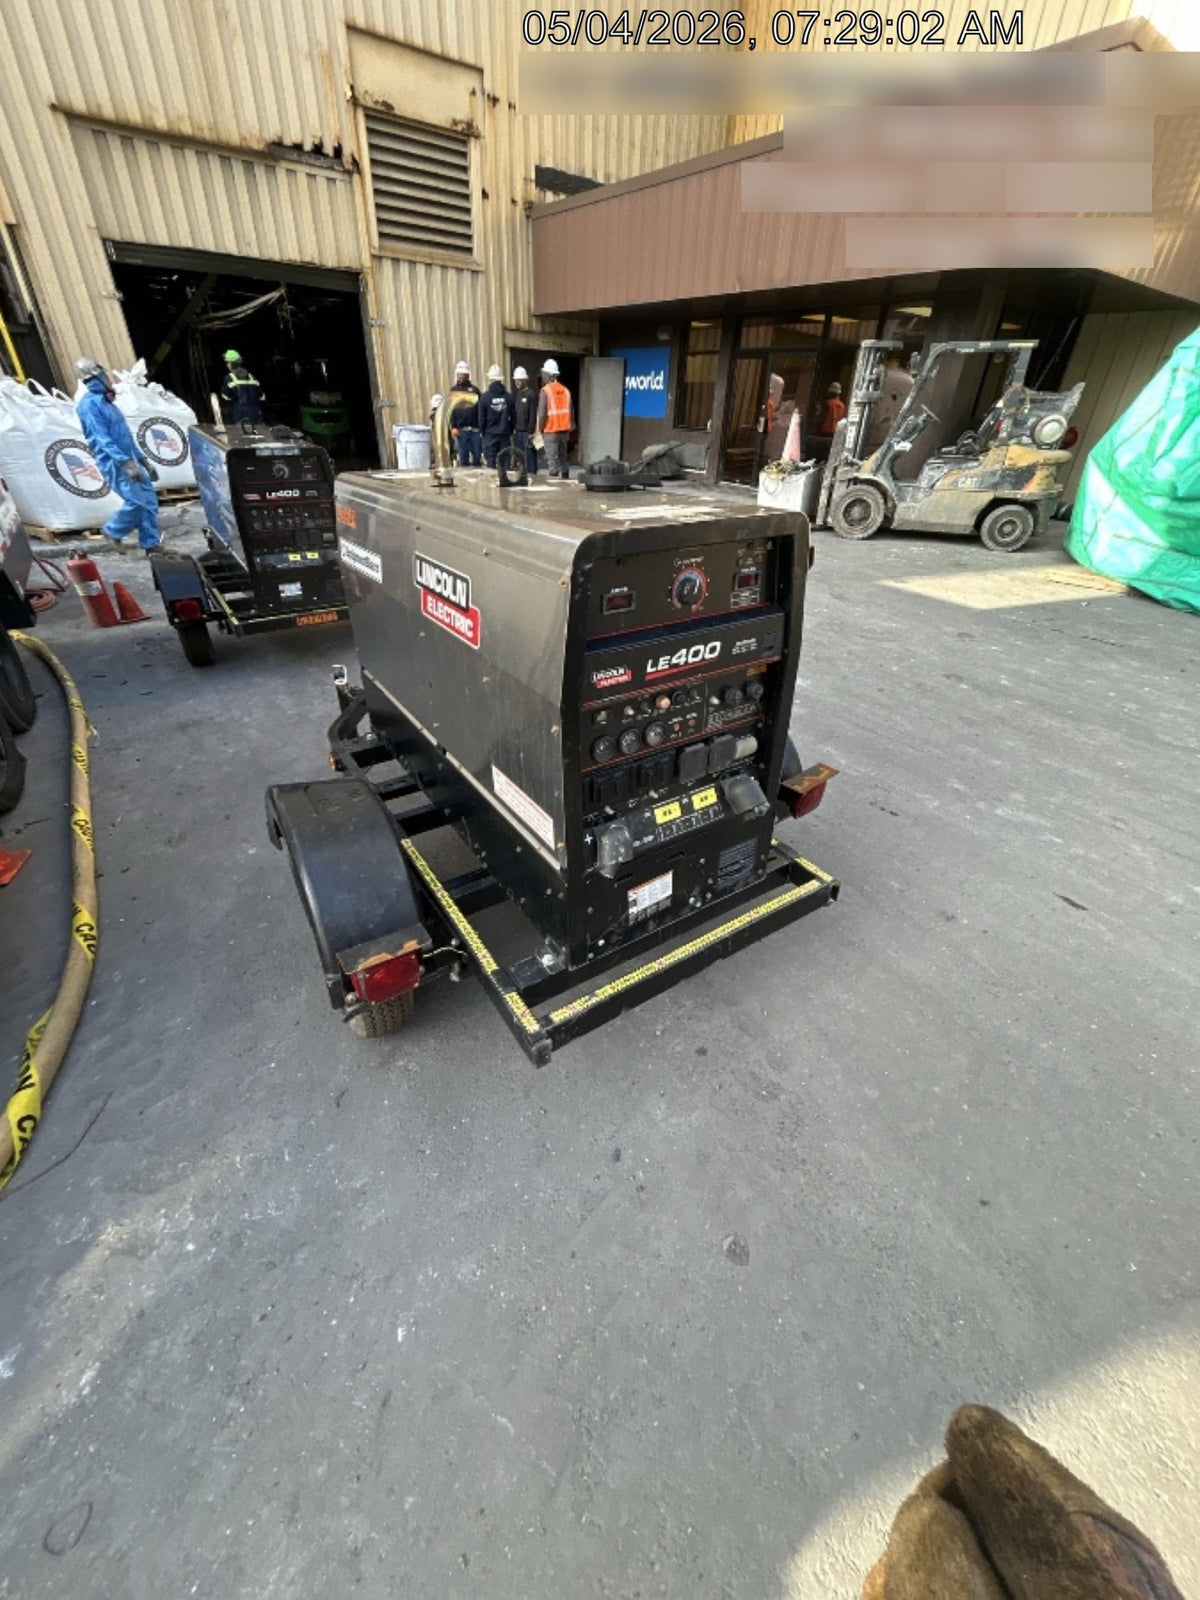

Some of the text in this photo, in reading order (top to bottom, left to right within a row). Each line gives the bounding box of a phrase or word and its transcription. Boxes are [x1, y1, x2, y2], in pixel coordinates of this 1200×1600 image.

[416, 558, 467, 609] LINCOLN
[426, 595, 475, 640] ELECTRIC
[646, 640, 722, 673] LE400
